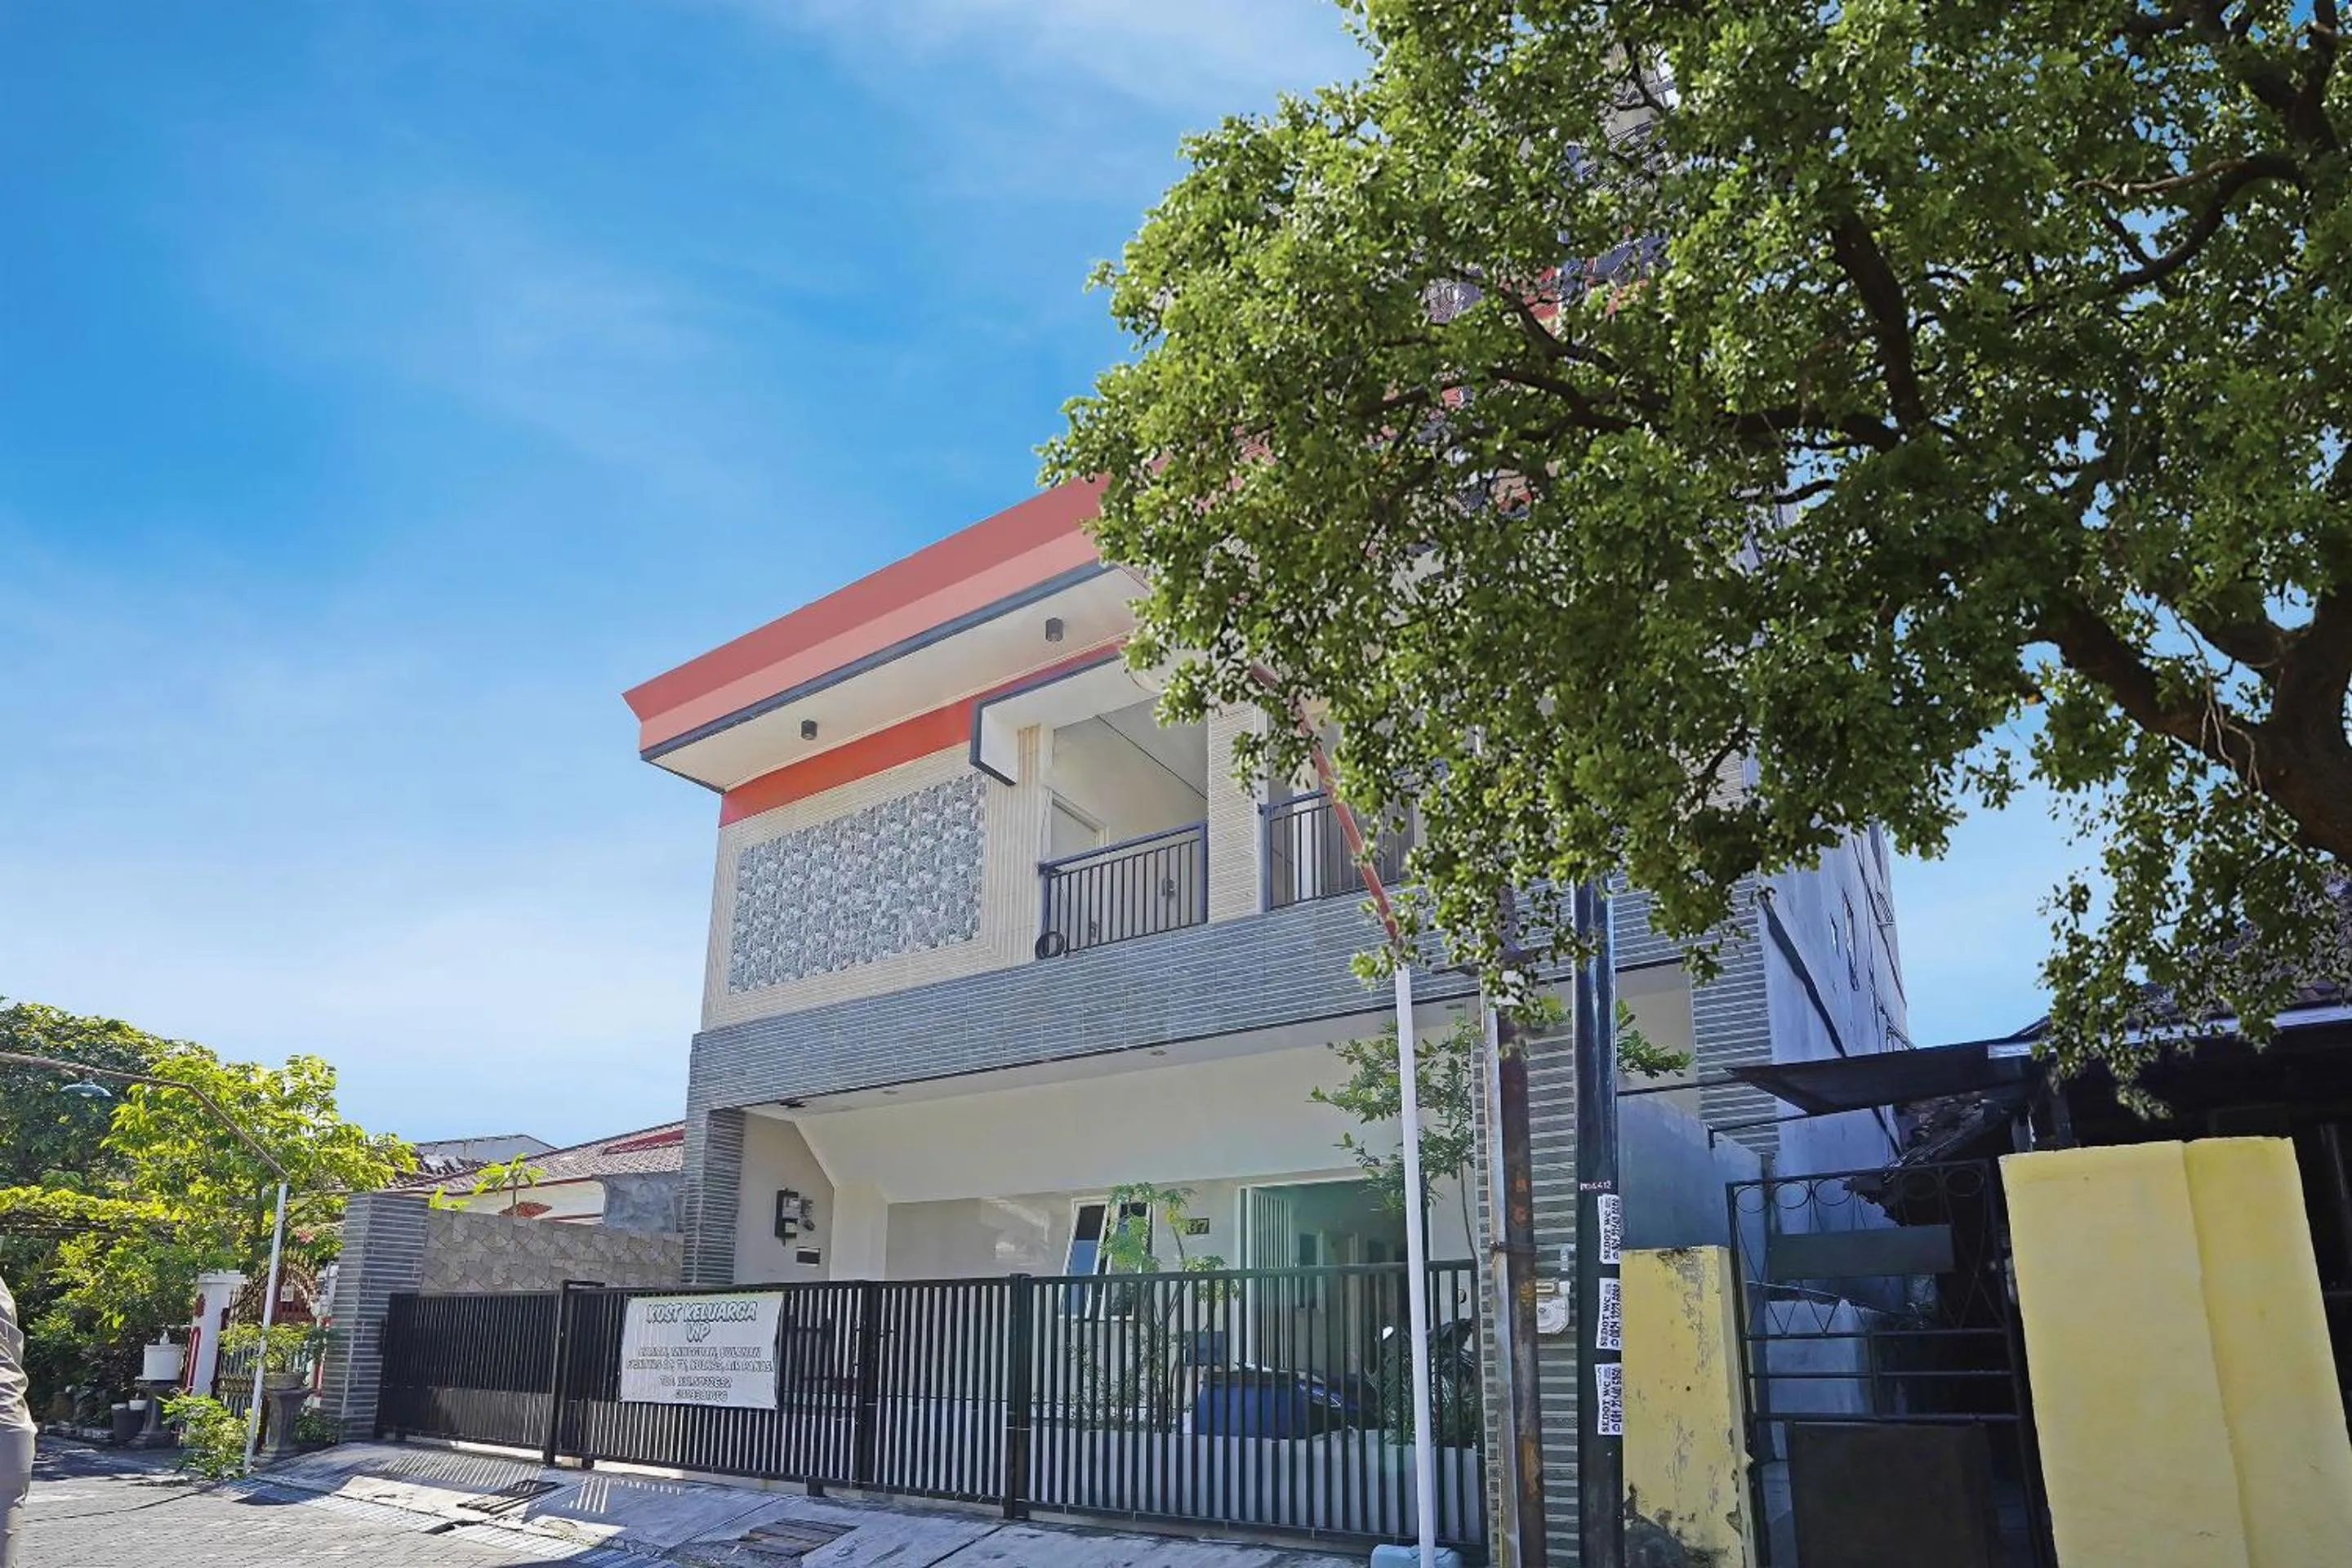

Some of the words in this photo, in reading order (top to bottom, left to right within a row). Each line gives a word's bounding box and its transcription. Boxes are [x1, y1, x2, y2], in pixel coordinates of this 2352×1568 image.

[1603, 1210, 1612, 1227] WC
[1602, 1228, 1612, 1260] SEDOT
[646, 1303, 683, 1323] KOST
[684, 1301, 758, 1322] KELUARGA
[1602, 1296, 1611, 1312] WC
[1599, 1314, 1610, 1348] SEDOT
[1602, 1380, 1611, 1397] WC
[1601, 1399, 1610, 1433] SEDOT
